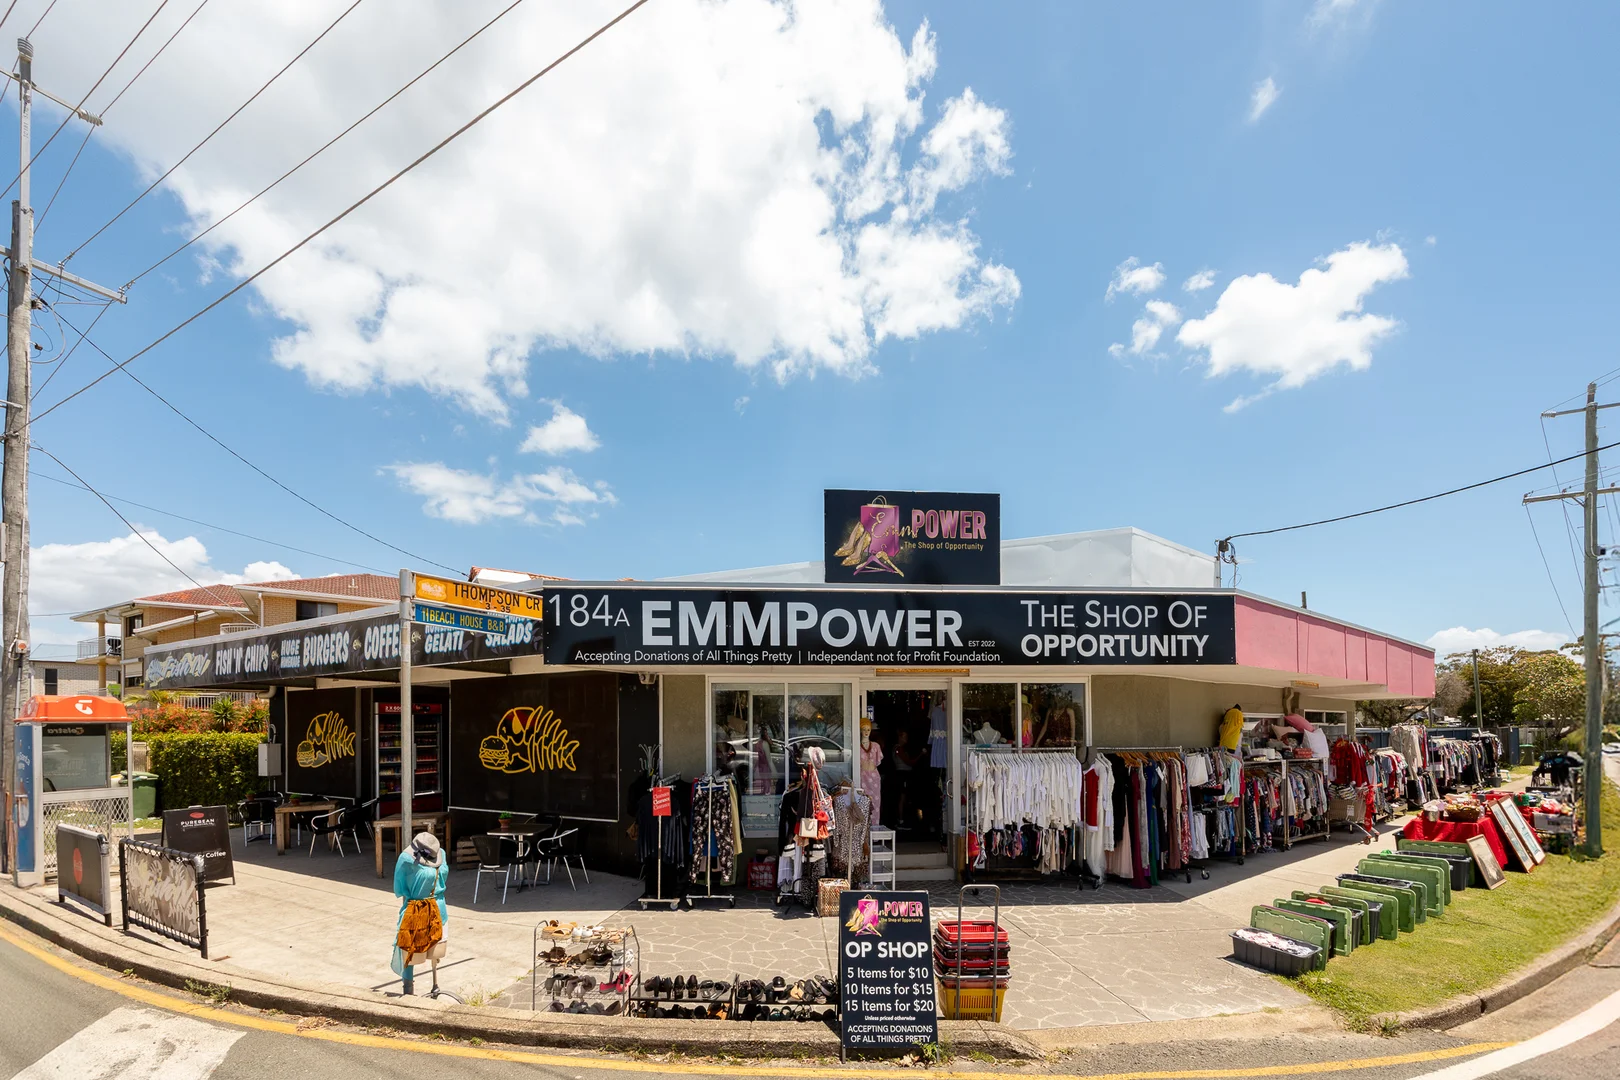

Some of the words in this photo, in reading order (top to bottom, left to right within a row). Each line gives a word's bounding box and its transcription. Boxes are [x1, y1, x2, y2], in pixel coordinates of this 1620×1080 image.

[918, 542, 935, 551] Shop
[945, 542, 984, 552] Opportunity
[452, 582, 520, 608] THOMPSON
[526, 596, 540, 611] CR
[485, 603, 491, 611] 3
[501, 605, 511, 614] 35
[548, 594, 631, 628] 184A
[1020, 600, 1075, 627] THE
[1085, 600, 1159, 628] SHOP
[1167, 600, 1208, 628] OF
[429, 609, 455, 625] BEACH
[460, 614, 484, 629] HOUSE
[487, 620, 504, 632] B&B
[281, 639, 301, 656] HUGE
[302, 630, 350, 667] BURGERS
[364, 624, 402, 660] COFFE
[424, 630, 465, 654] GELATI
[1020, 634, 1210, 658] OPPORTUNITY
[215, 648, 232, 676] FISH
[244, 642, 269, 673] CHIPS
[575, 650, 631, 664] Accepting
[634, 650, 689, 663] Donations
[692, 650, 705, 662] of
[706, 650, 720, 662] All
[723, 650, 759, 664] Things
[762, 650, 793, 664] Pretty
[807, 650, 874, 664] Independant
[877, 652, 894, 663] not
[896, 651, 911, 663] for
[914, 651, 941, 663] Profit
[943, 651, 1001, 663] Foundation
[883, 901, 924, 917] POWER
[845, 941, 872, 958] OP
[877, 941, 929, 959] SHOP
[847, 967, 854, 978] 5
[857, 967, 887, 978] Items
[889, 967, 906, 978] for
[908, 966, 929, 979] $10
[844, 983, 858, 995] 10
[861, 983, 891, 995] Items
[893, 983, 910, 994] for
[912, 983, 933, 995] $15
[845, 1000, 858, 1011] 15
[862, 1000, 892, 1011] Items
[894, 1000, 911, 1011] for
[913, 1000, 934, 1012] $20
[847, 1025, 889, 1033] ACCEPTING
[890, 1025, 933, 1033] DONATIONS
[850, 1035, 861, 1043] OF
[862, 1035, 876, 1043] ALL
[877, 1035, 904, 1043] THINGS
[905, 1035, 931, 1043] PRETTY
